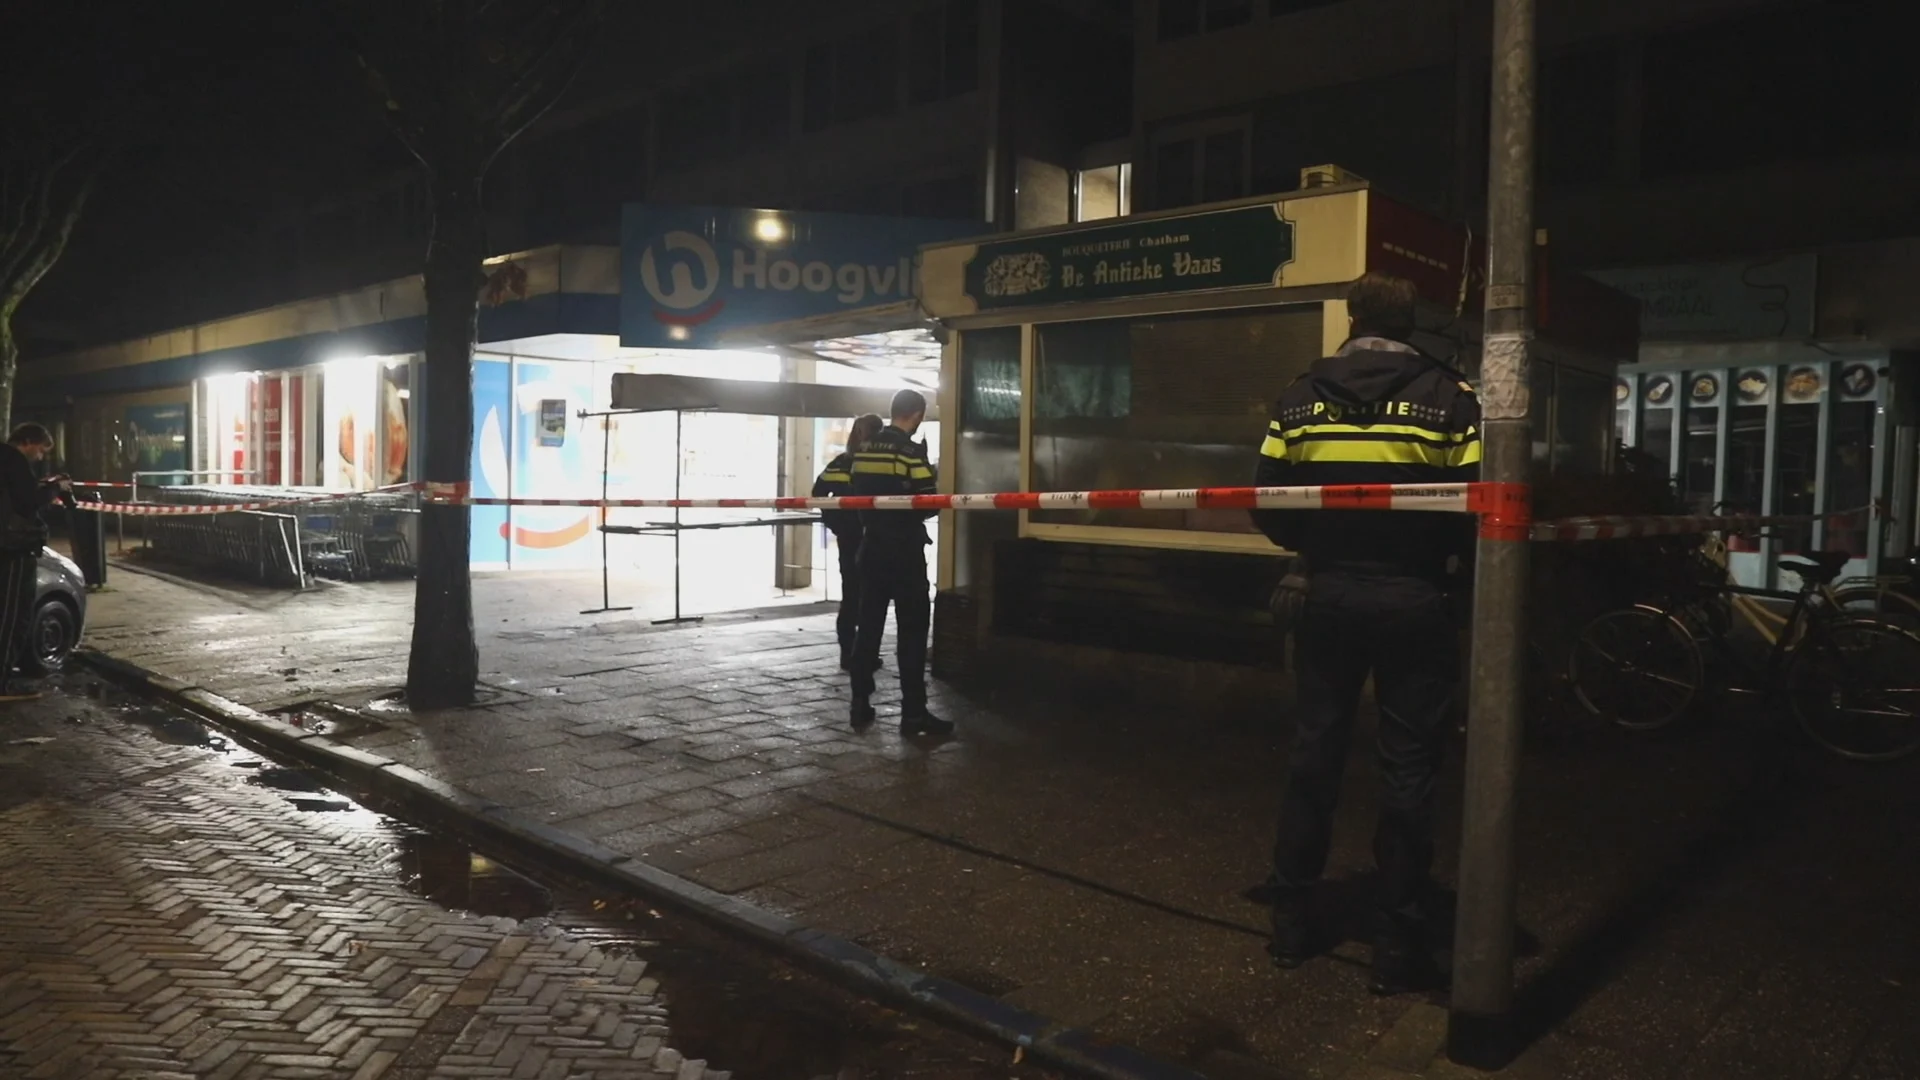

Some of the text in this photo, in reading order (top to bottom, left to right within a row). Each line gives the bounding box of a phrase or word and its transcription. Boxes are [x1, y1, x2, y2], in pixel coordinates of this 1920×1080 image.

[1139, 234, 1190, 247] Chatham
[1061, 252, 1222, 288] De Antieke Vaas
